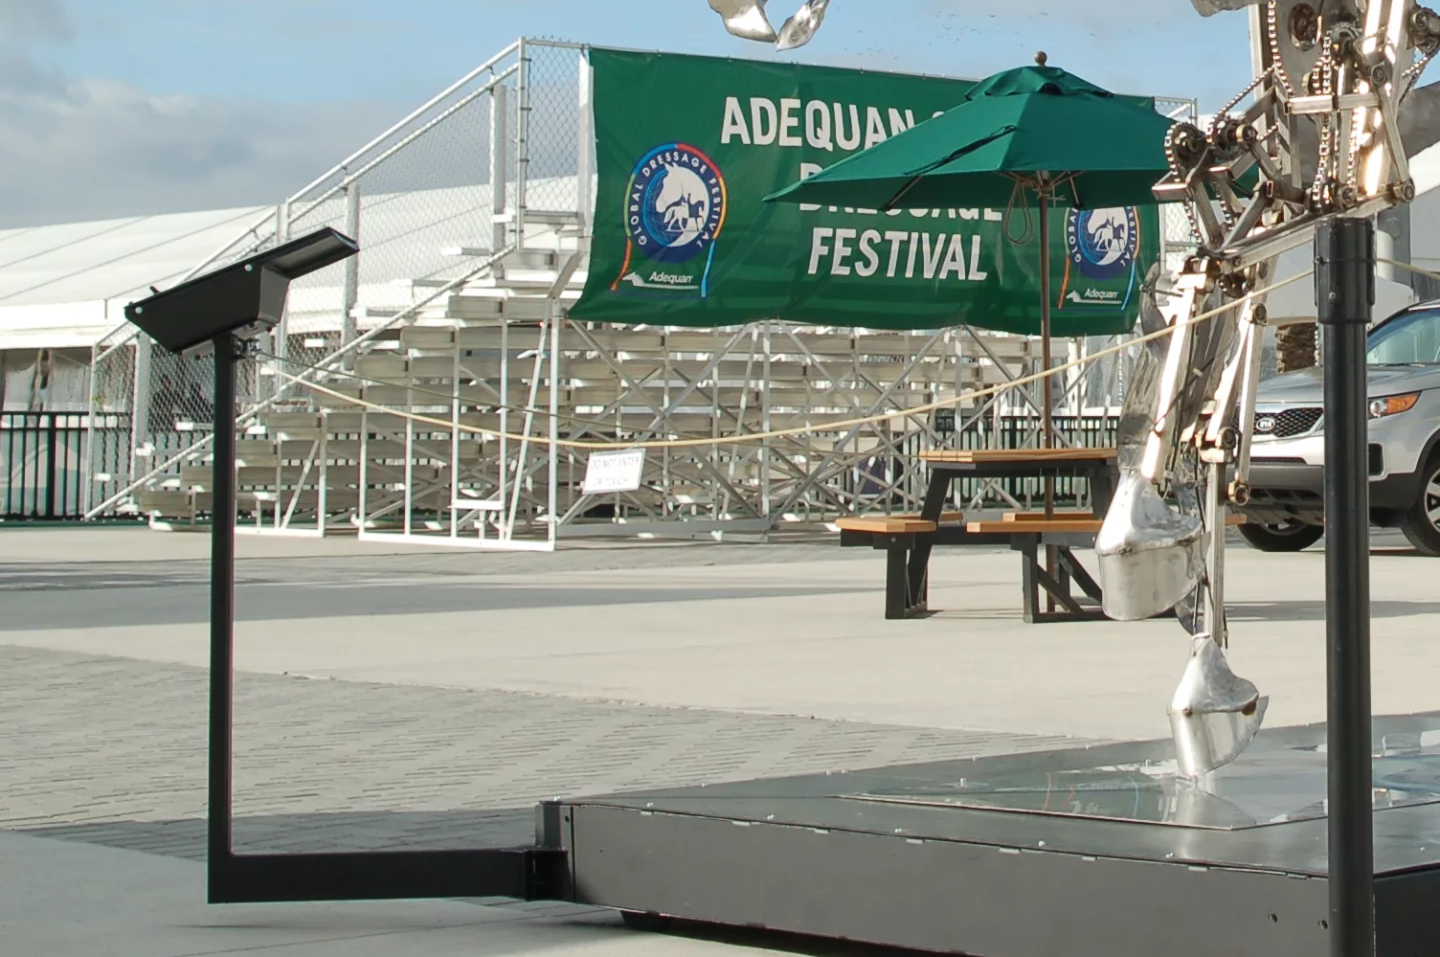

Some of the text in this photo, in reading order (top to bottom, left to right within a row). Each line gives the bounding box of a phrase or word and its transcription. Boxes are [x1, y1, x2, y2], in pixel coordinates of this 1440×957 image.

[630, 151, 721, 248] GLOBAL DRESSAGE FESTIVAL
[807, 227, 988, 281] FESTIVAL
[1120, 207, 1136, 267] ESTIVAL
